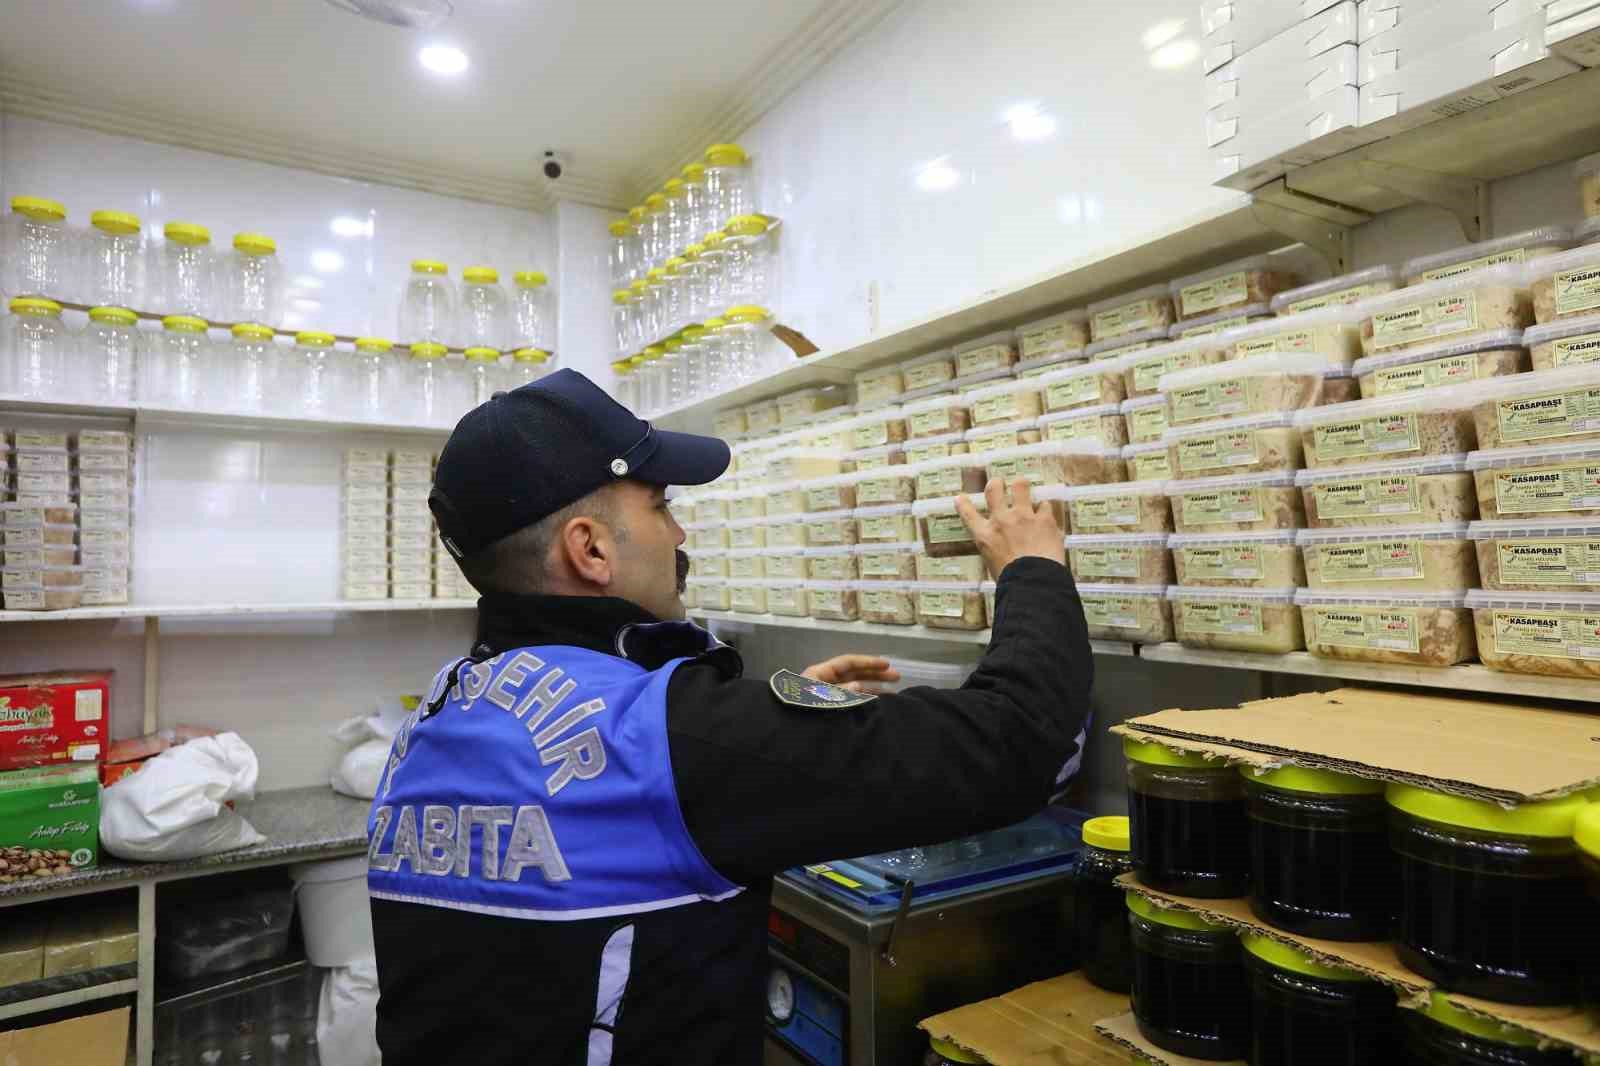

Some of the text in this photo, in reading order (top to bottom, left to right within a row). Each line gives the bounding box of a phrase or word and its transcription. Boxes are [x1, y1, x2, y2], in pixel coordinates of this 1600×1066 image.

[1509, 617, 1558, 628] KASAPBAŞI
[382, 651, 607, 797] ŞEHİR
[368, 804, 572, 882] ZABITA
